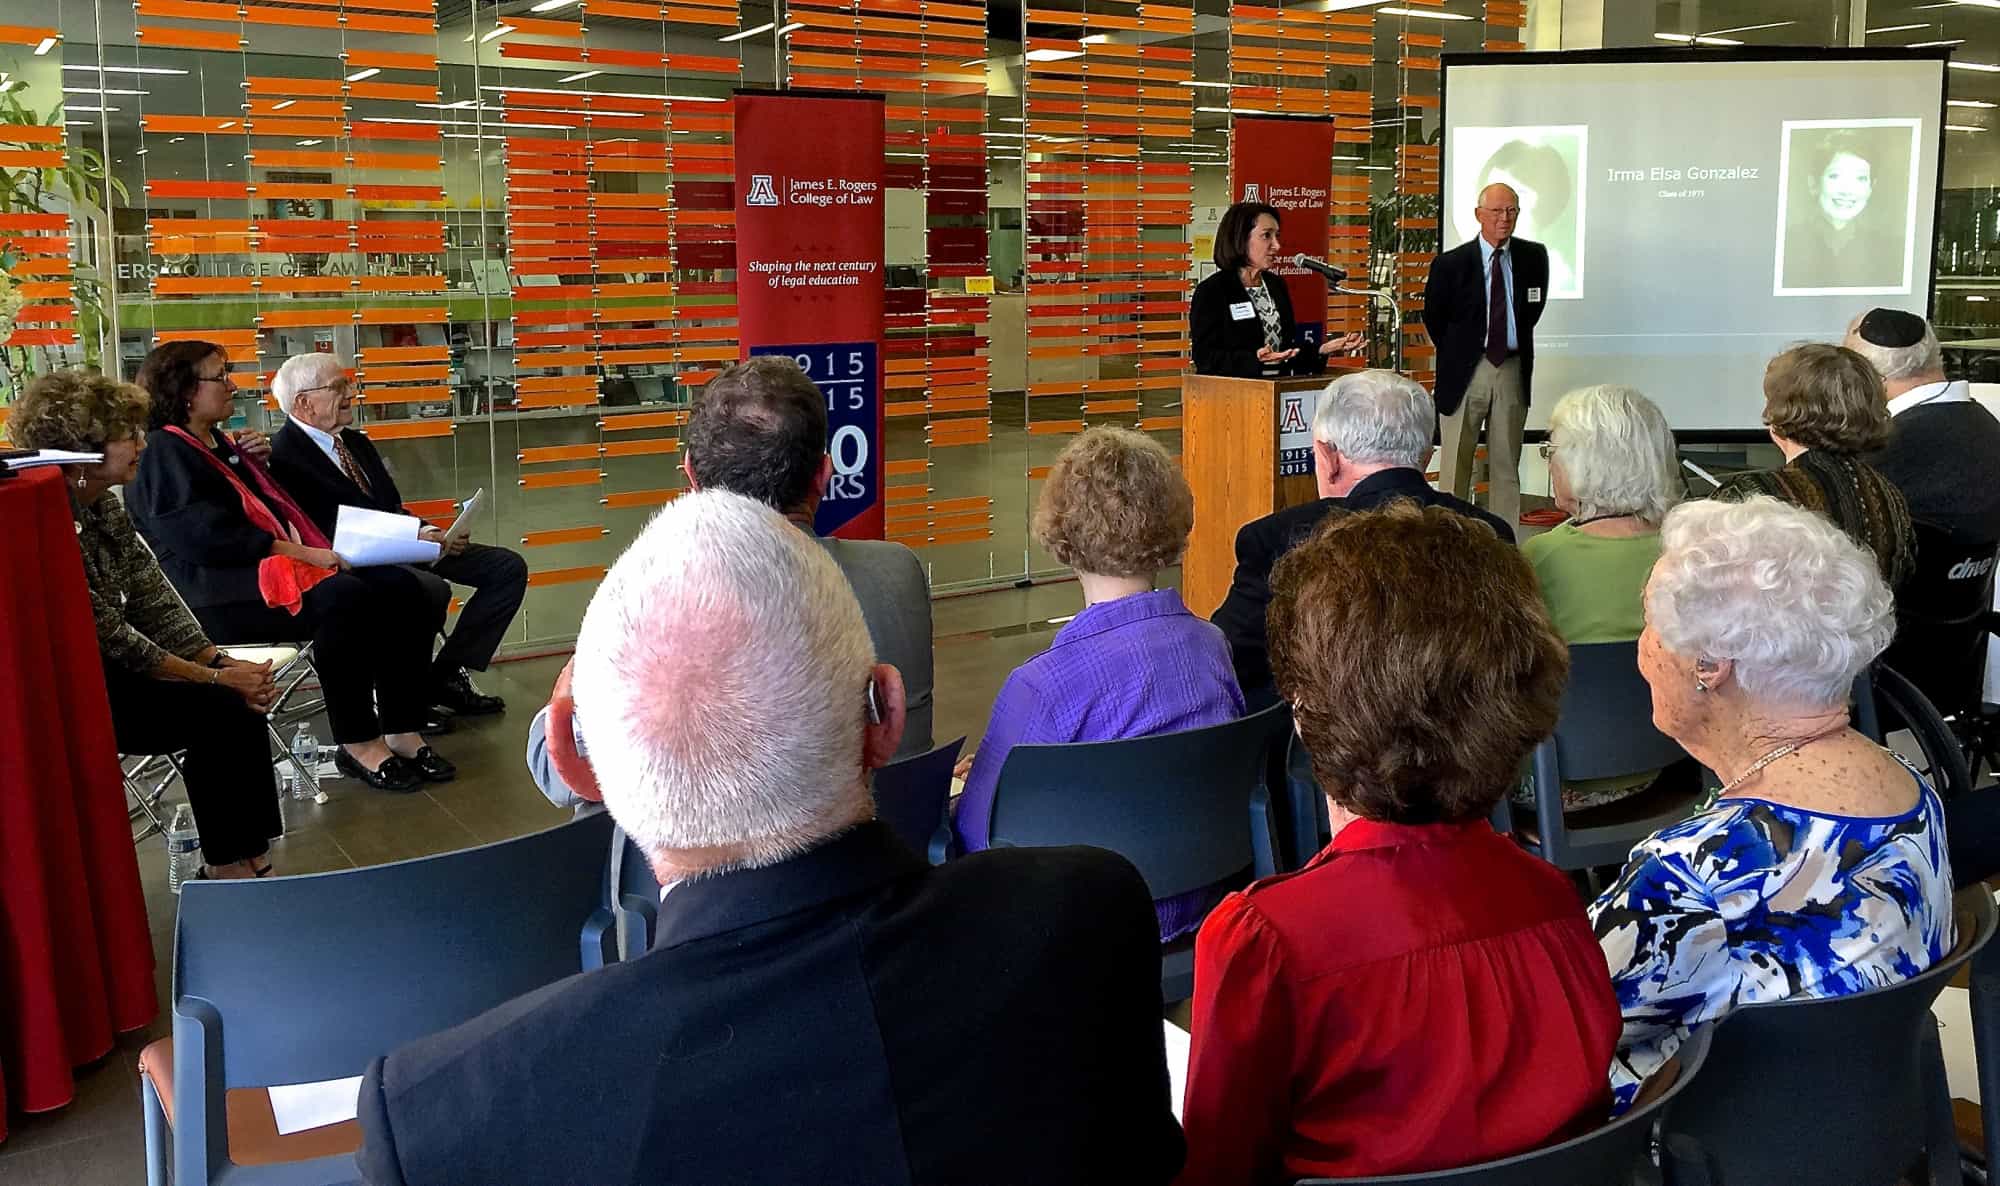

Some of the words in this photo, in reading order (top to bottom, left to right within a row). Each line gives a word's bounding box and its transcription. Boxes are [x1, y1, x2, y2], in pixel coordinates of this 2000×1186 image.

[1607, 168, 1644, 182] Irma
[1650, 166, 1681, 181] Elsa
[1687, 165, 1760, 180] Gonzalez
[790, 178, 825, 192] James
[827, 179, 837, 190] E.
[839, 179, 877, 193] Rogers
[1269, 187, 1292, 198] James
[1301, 187, 1327, 199] Rogers
[790, 192, 833, 207] College
[835, 193, 848, 204] of
[850, 193, 873, 205] Law
[1269, 198, 1297, 210] College
[1298, 198, 1307, 208] of
[1308, 198, 1324, 208] Law
[117, 263, 158, 280] ERS
[748, 260, 792, 274] Shaping
[794, 260, 811, 272] the
[813, 261, 836, 272] next
[838, 261, 877, 273] century
[768, 275, 781, 289] of
[781, 275, 806, 288] legal
[808, 274, 859, 286] education
[795, 352, 865, 376] 915
[826, 386, 865, 411] 15
[1280, 463, 1308, 475] 2015
